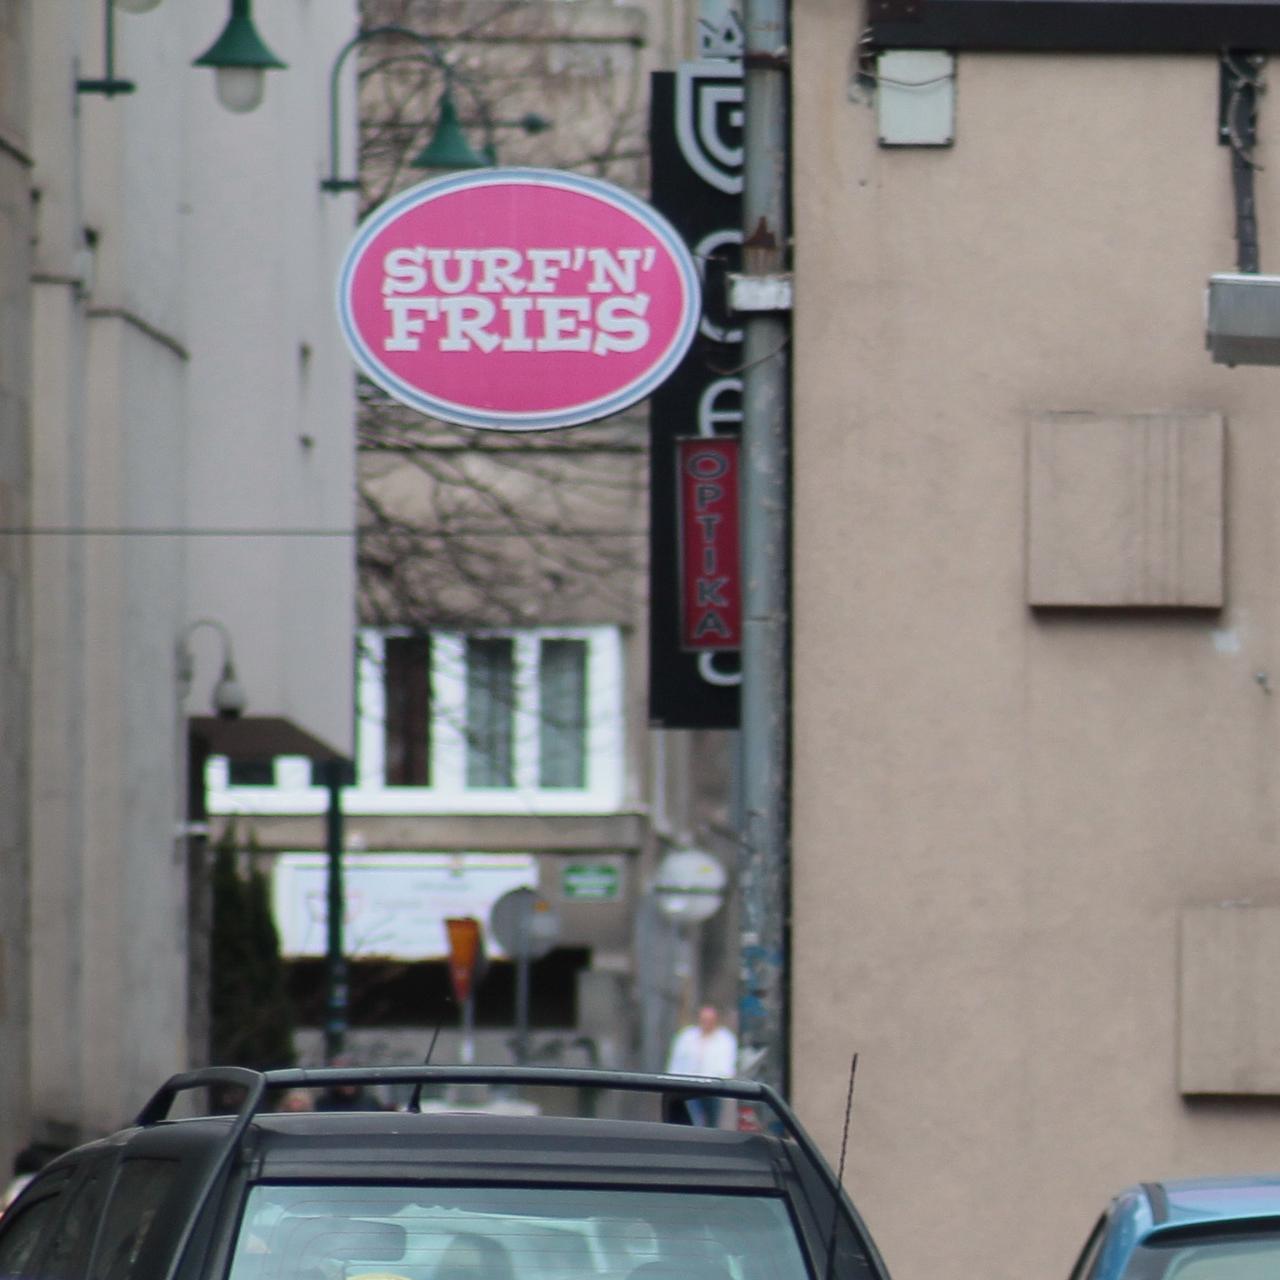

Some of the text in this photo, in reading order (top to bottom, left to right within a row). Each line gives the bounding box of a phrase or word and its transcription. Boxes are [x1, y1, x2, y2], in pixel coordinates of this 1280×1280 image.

[382, 246, 657, 296] SURF'N'
[383, 294, 651, 356] FRIES
[686, 450, 734, 638] OPTIKA
